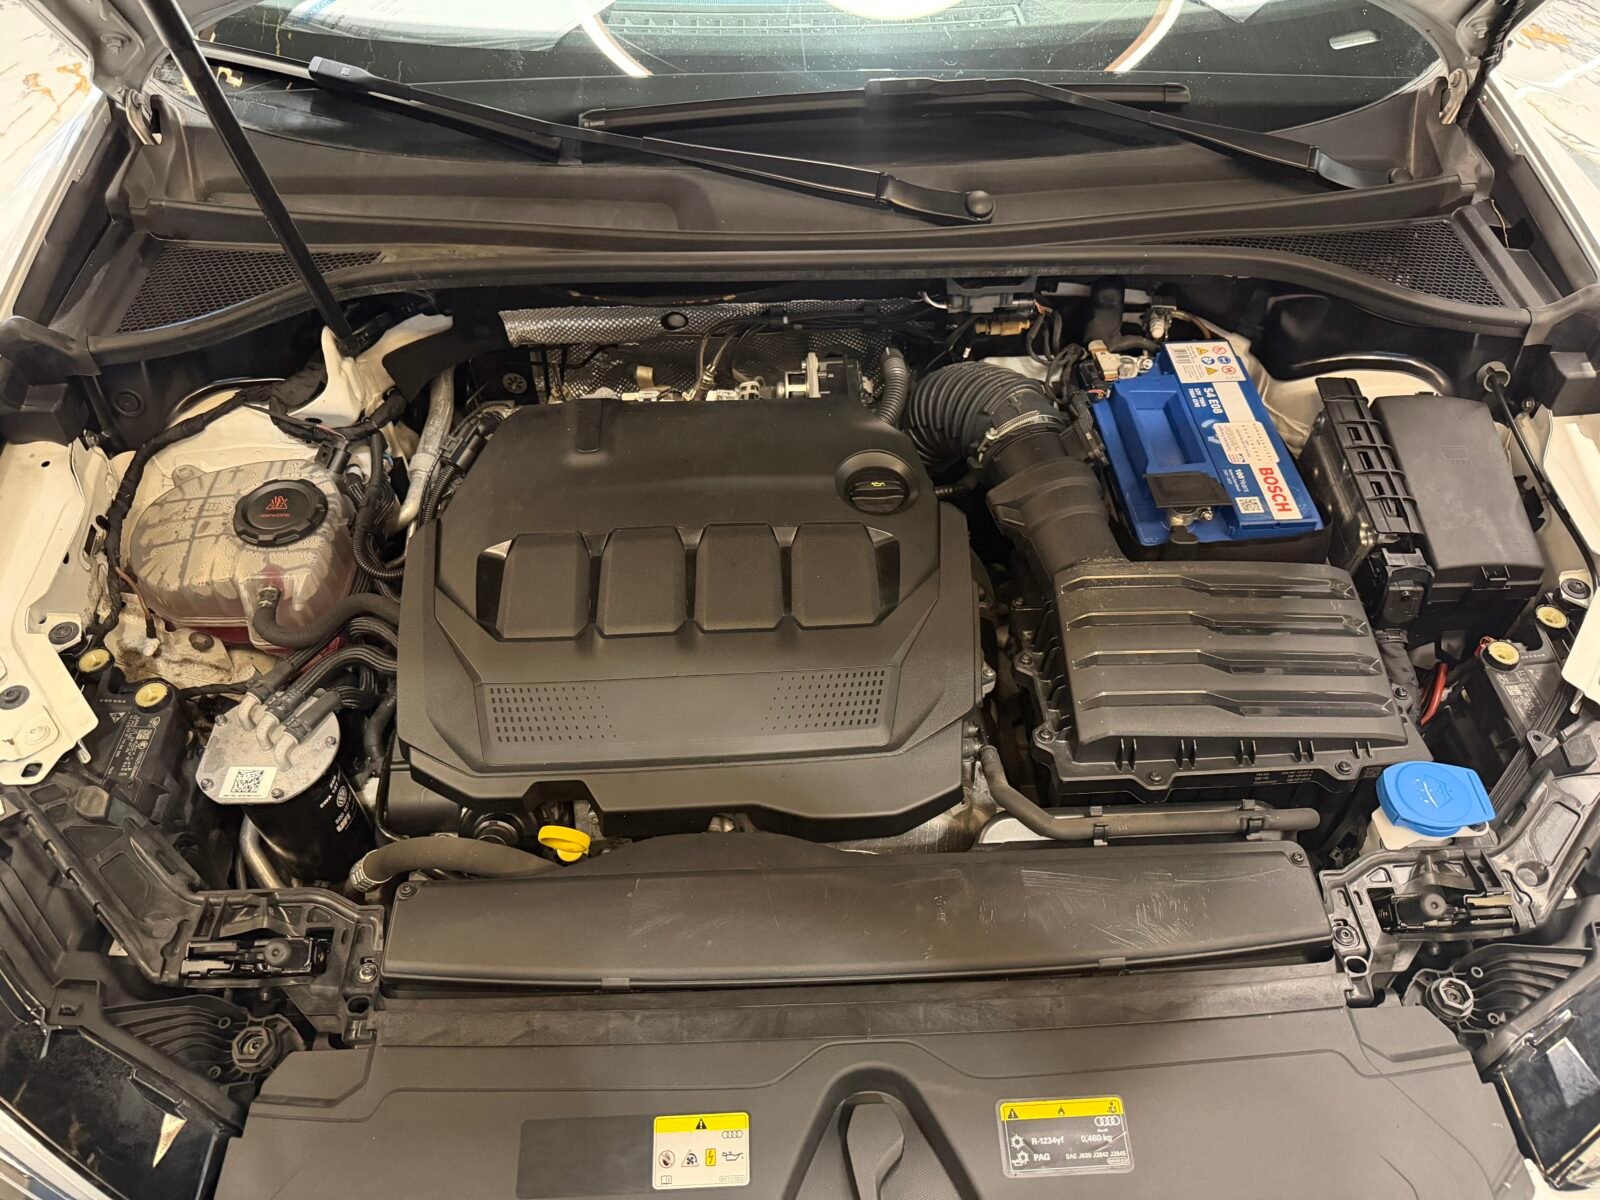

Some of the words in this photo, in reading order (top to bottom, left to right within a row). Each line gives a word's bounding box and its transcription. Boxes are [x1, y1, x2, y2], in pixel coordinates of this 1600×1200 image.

[1203, 387, 1216, 398] S4
[1208, 399, 1223, 414] E08
[1258, 467, 1292, 512] BOSCH
[1031, 1136, 1064, 1146] R-1234yf
[1102, 1133, 1113, 1143] kg
[1033, 1153, 1051, 1162] PAG
